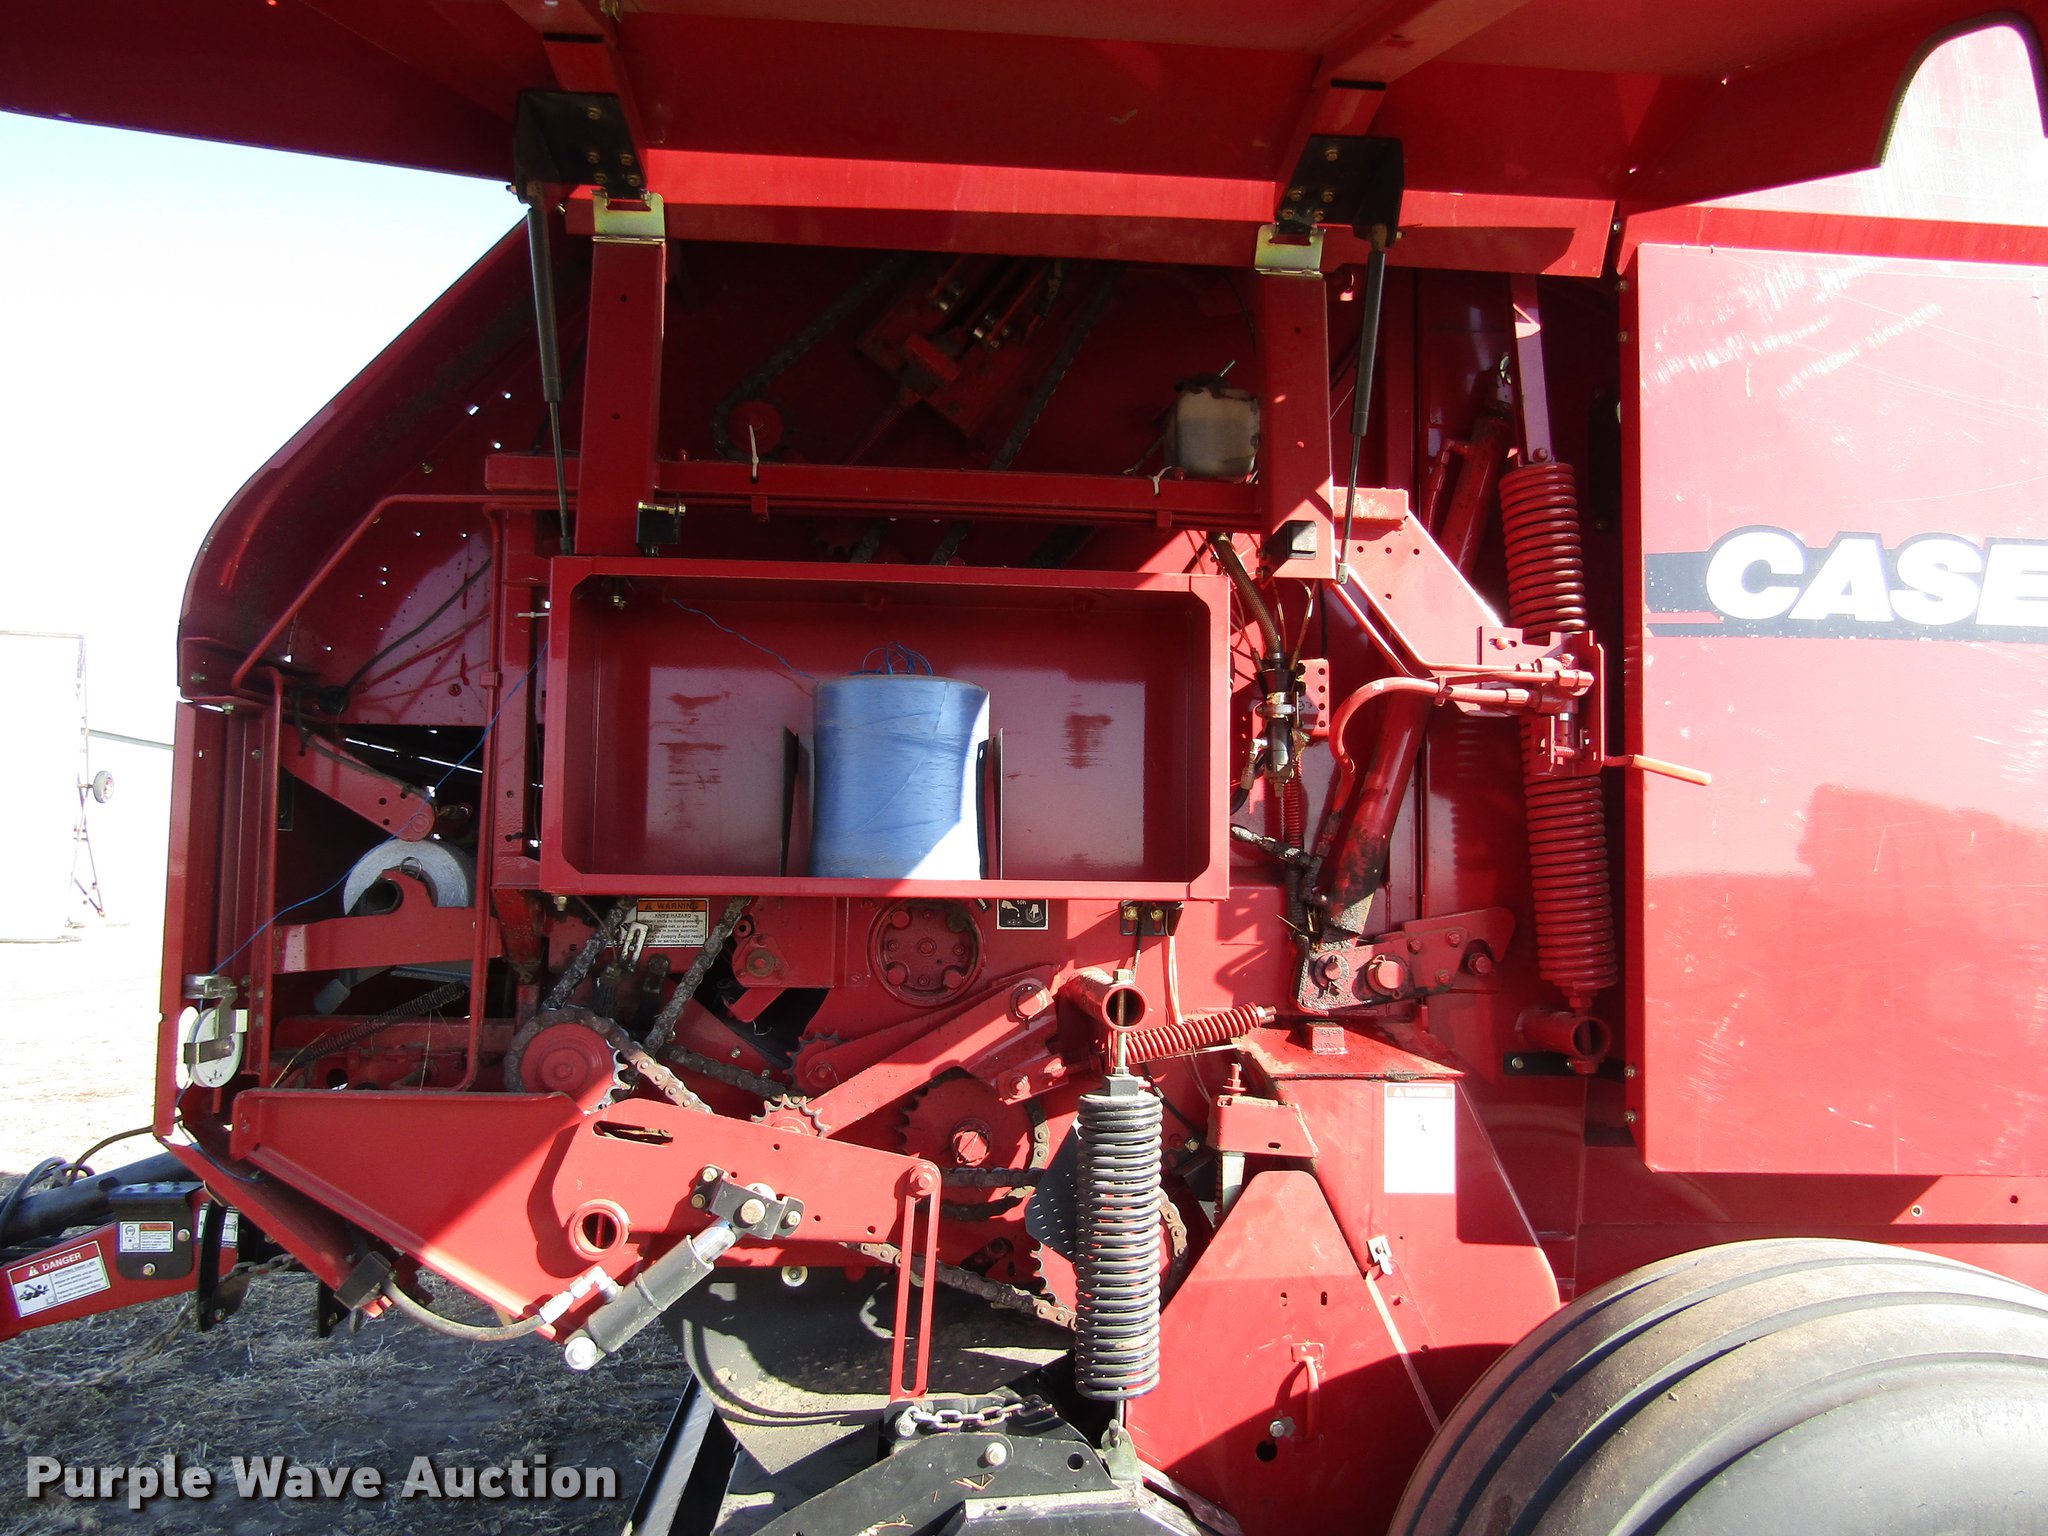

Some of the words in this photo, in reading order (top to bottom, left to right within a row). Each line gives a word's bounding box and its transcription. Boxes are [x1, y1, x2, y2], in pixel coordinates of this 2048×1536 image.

[1705, 531, 2048, 627] CASE
[656, 902, 698, 910] WARNING
[42, 1252, 82, 1271] DANGER
